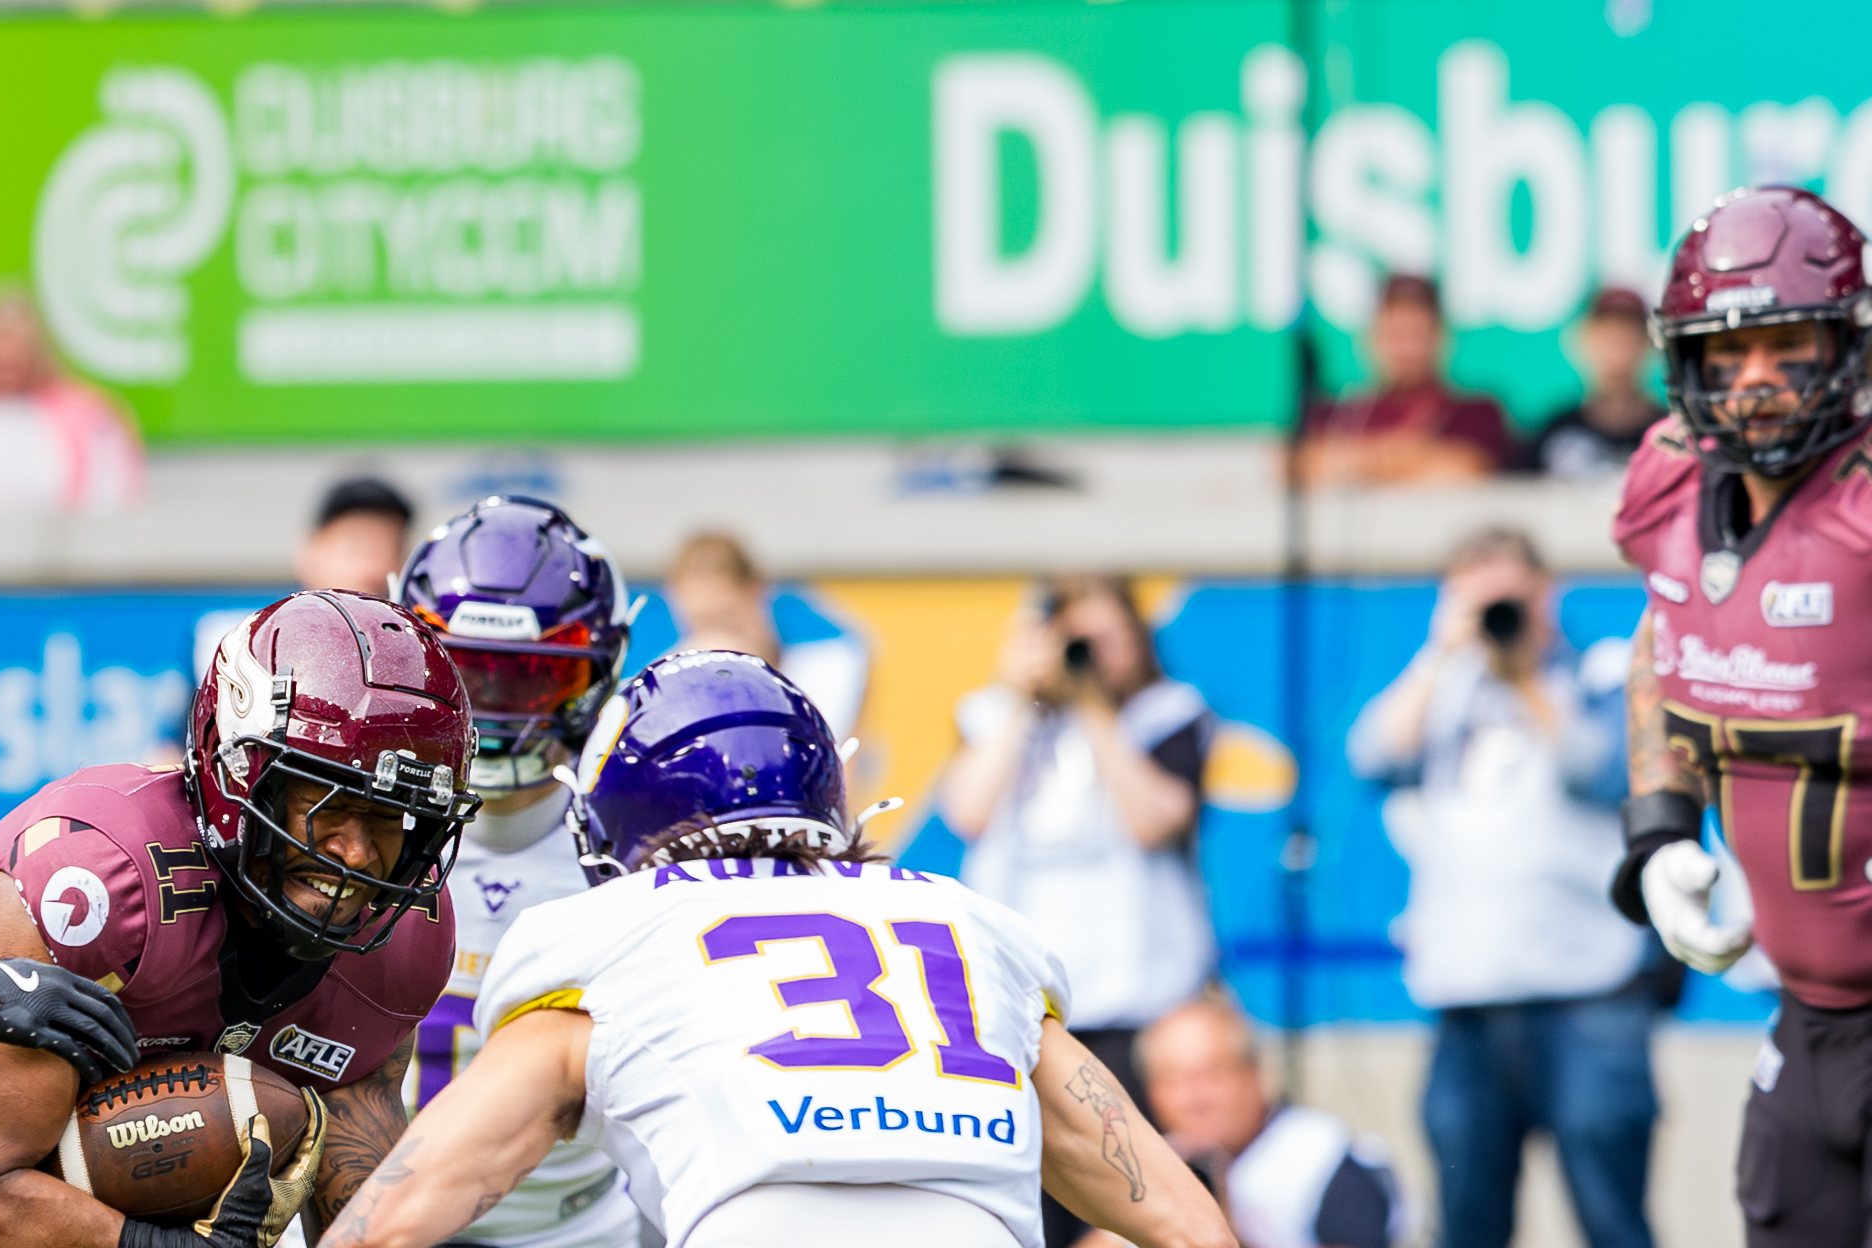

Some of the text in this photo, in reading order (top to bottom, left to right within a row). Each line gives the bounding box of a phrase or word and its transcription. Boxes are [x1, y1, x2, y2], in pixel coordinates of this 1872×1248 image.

[146, 842, 217, 924] 11
[696, 911, 1022, 1091] 31
[279, 1034, 349, 1072] AFLE
[106, 1111, 205, 1148] Wilson
[766, 1096, 1015, 1145] Verbund
[131, 1150, 194, 1180] GST
